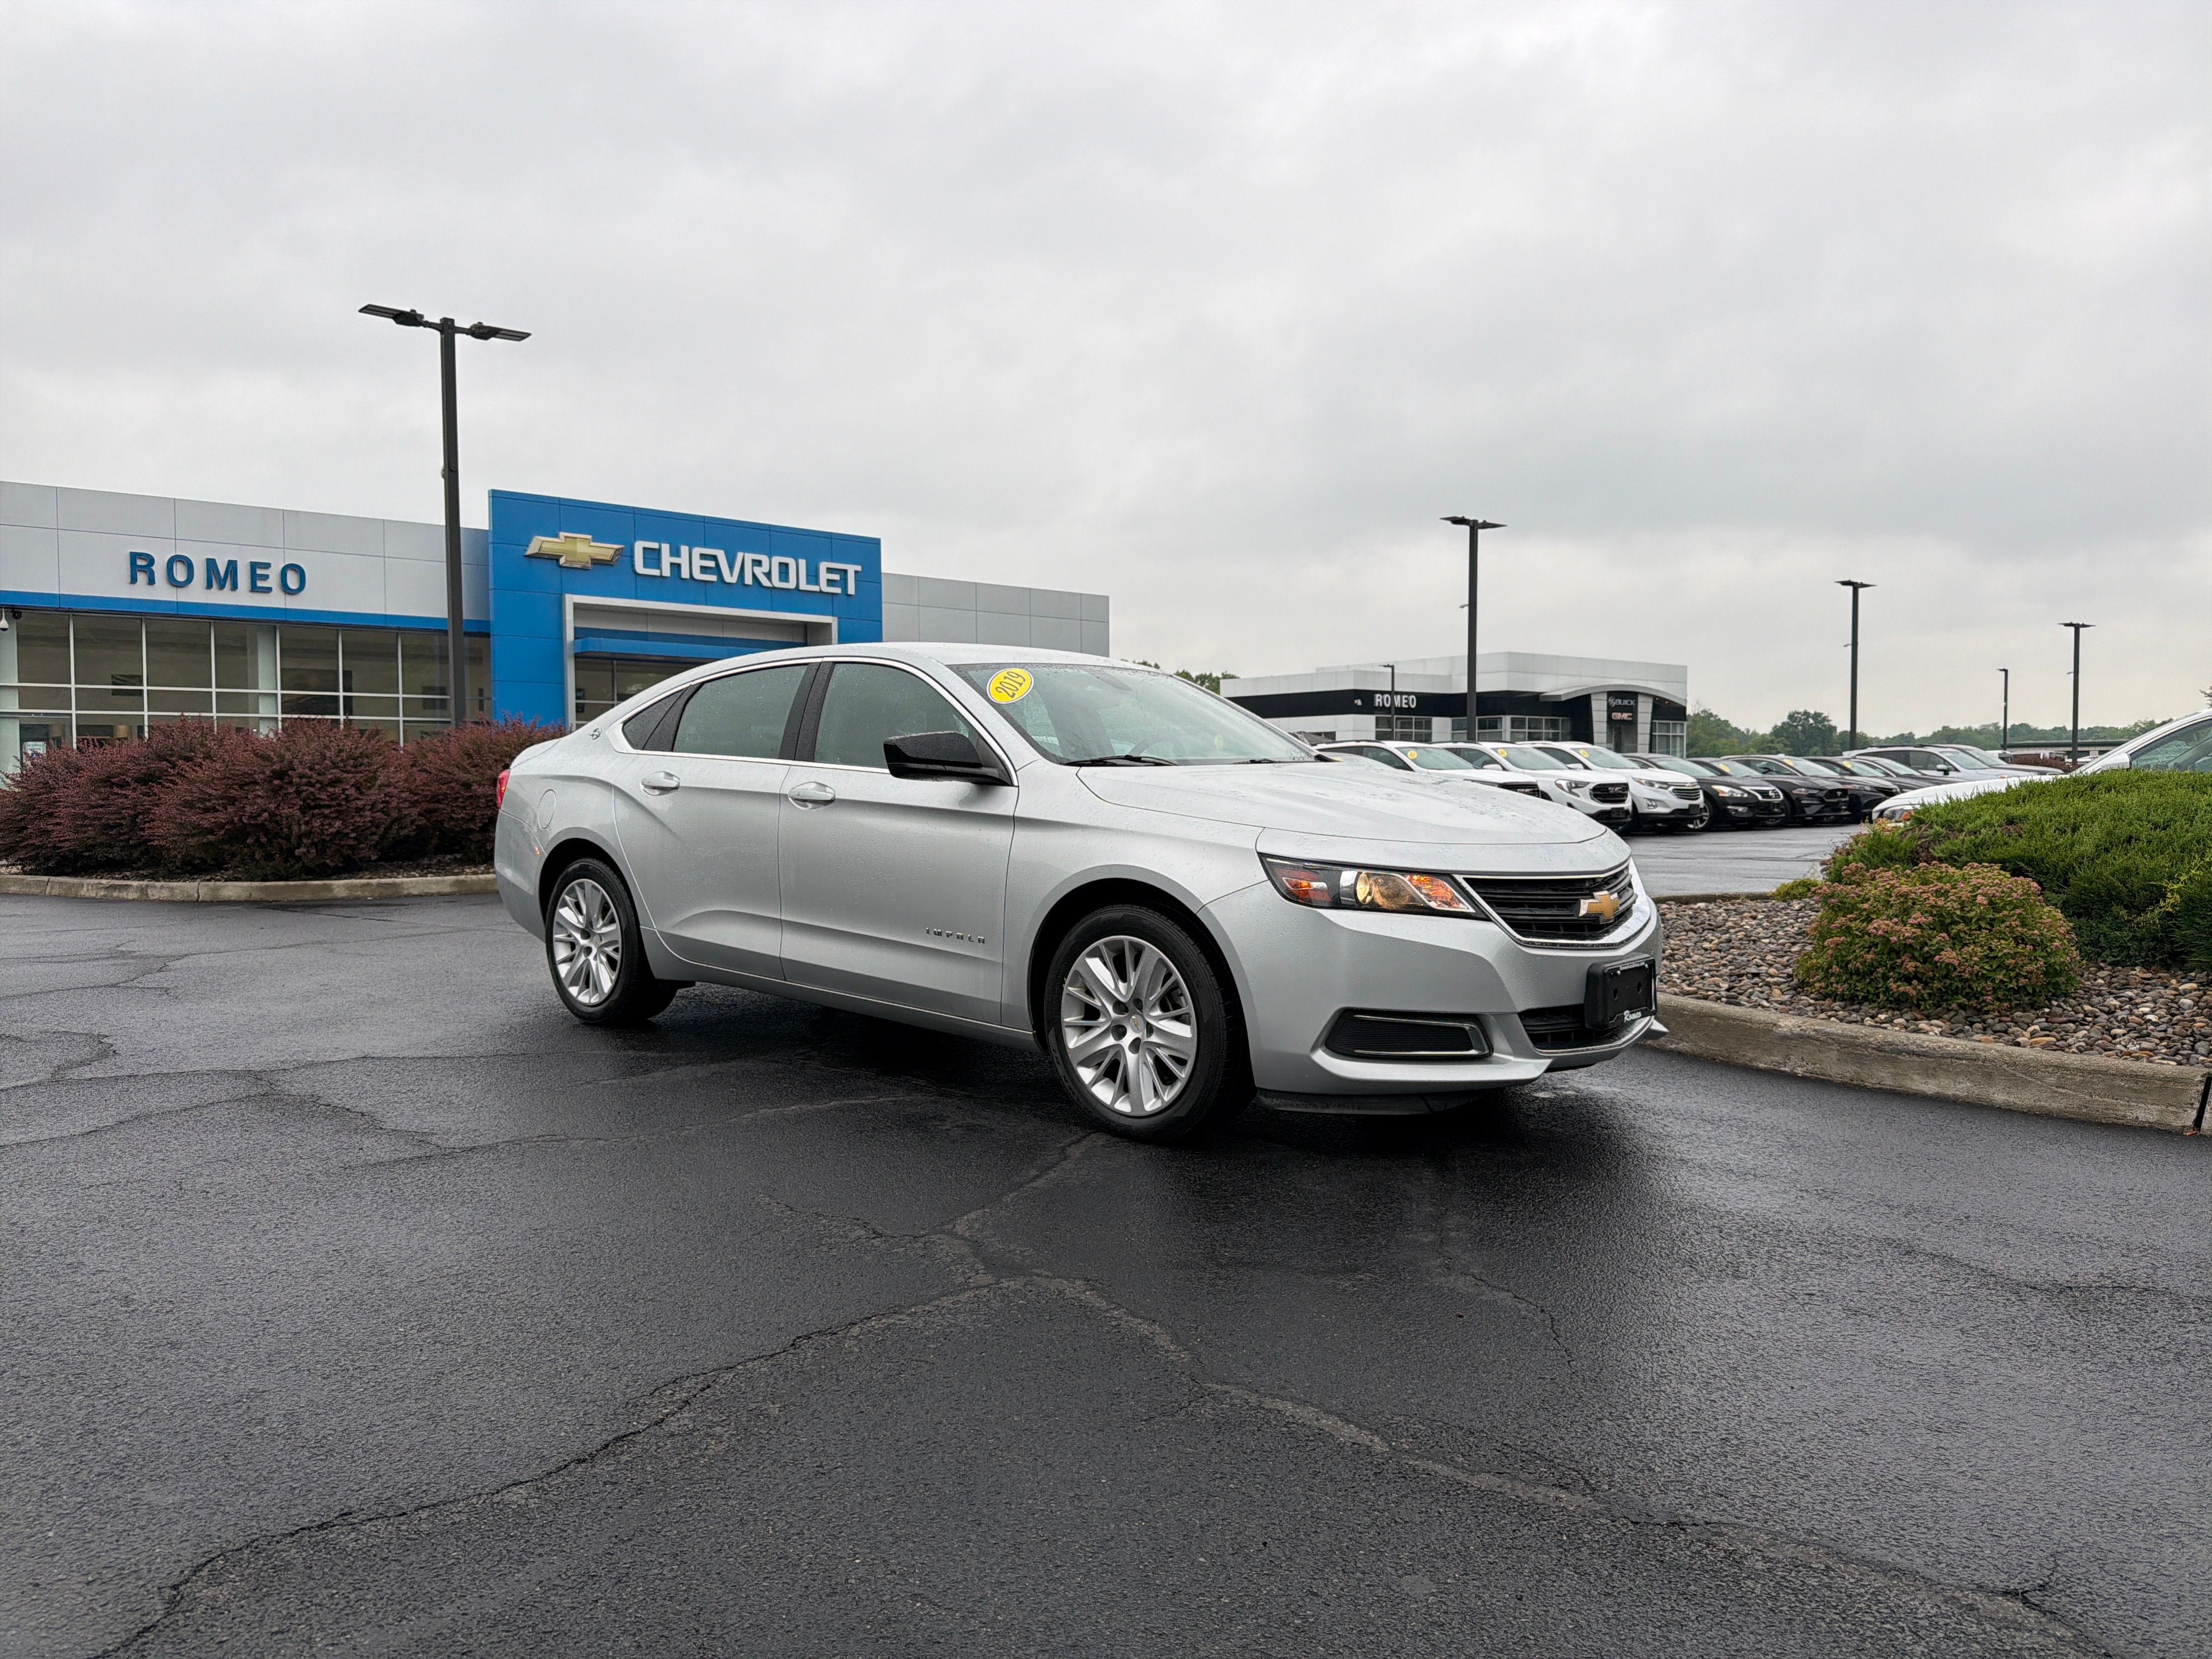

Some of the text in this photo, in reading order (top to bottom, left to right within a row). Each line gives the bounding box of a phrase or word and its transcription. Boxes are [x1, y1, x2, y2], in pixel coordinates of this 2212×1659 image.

[129, 551, 307, 595] ROMEO
[634, 540, 862, 595] CHEVROLET
[995, 671, 1026, 699] 2019
[1374, 693, 1417, 708] ROMEO
[1611, 712, 1633, 721] GMC
[926, 927, 985, 945] IMPALA
